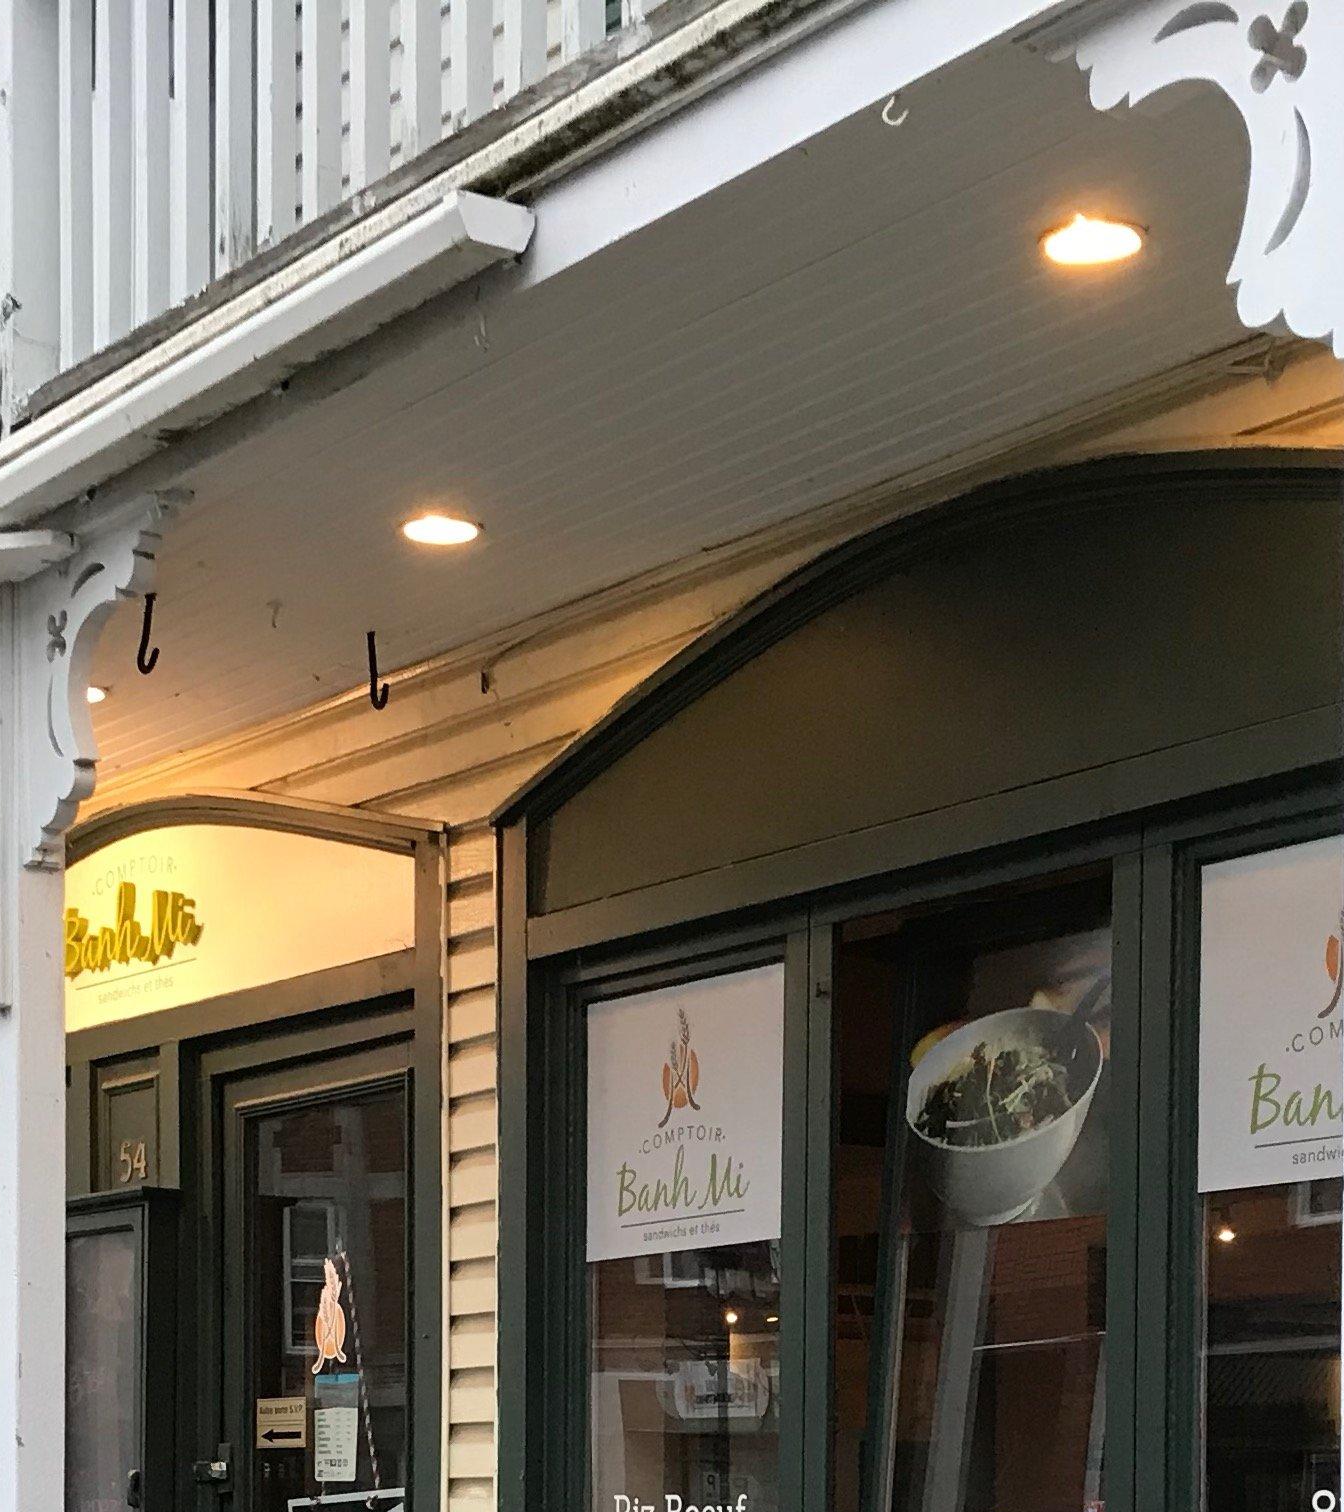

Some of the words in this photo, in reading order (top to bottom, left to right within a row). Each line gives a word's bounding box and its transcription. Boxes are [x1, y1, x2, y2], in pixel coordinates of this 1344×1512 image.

[65, 880, 144, 982] Banh
[1248, 1062, 1343, 1135] Ban
[119, 1140, 147, 1183] 54
[616, 1144, 697, 1217] Banh
[697, 1153, 750, 1210] Mi
[1292, 1146, 1343, 1165] sandwi
[689, 1225, 698, 1236] et
